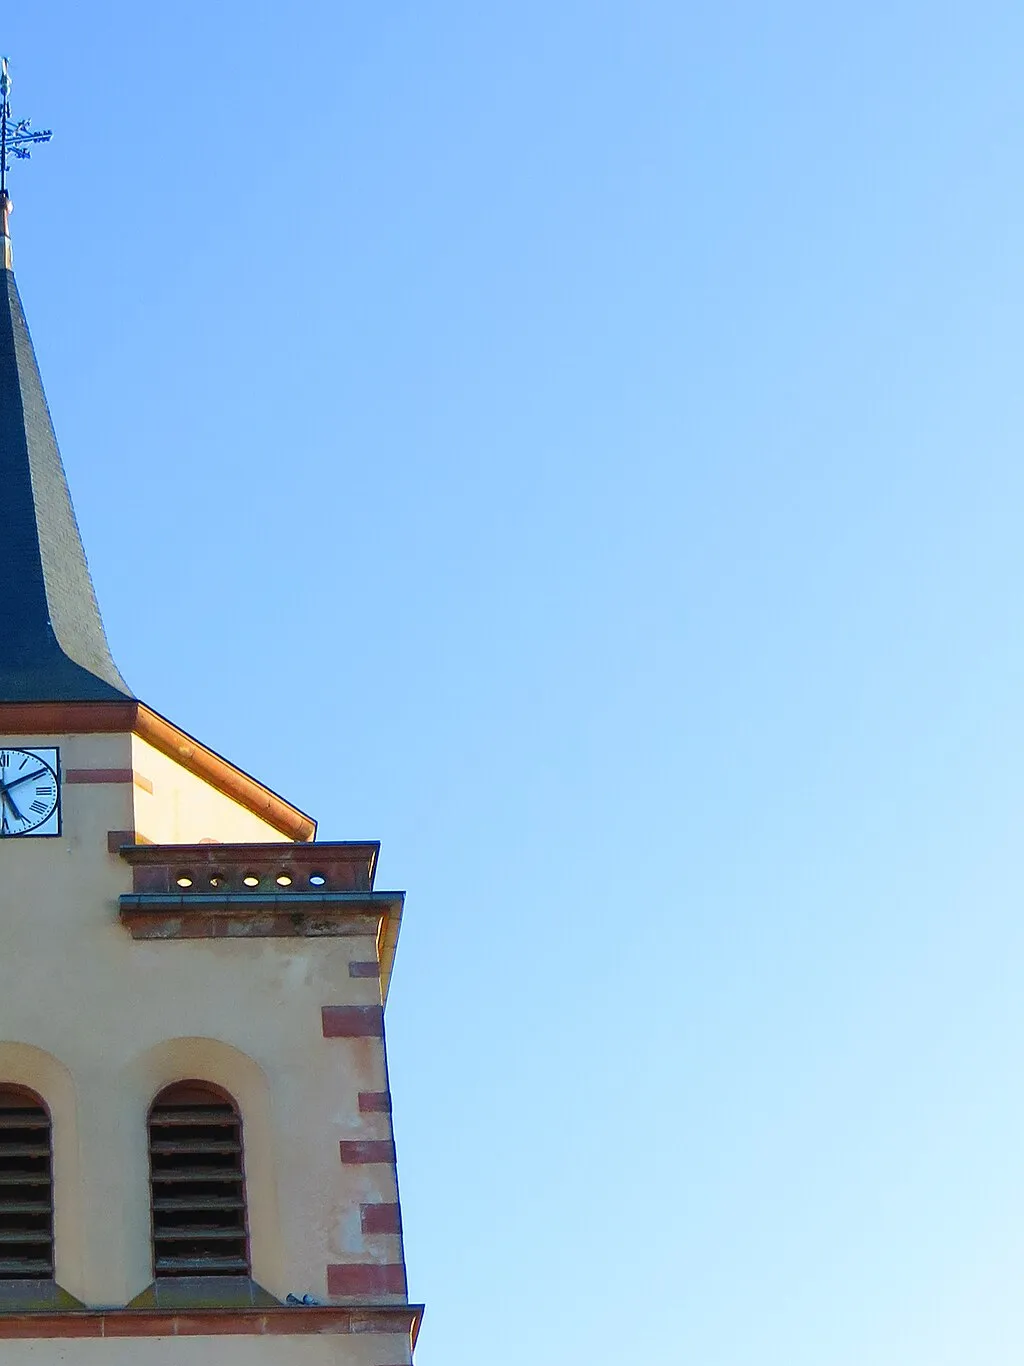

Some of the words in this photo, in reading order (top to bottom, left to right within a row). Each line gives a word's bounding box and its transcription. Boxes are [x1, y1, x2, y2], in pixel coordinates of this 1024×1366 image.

[19, 758, 28, 770] I
[36, 787, 52, 796] III
[29, 800, 49, 815] IIII
